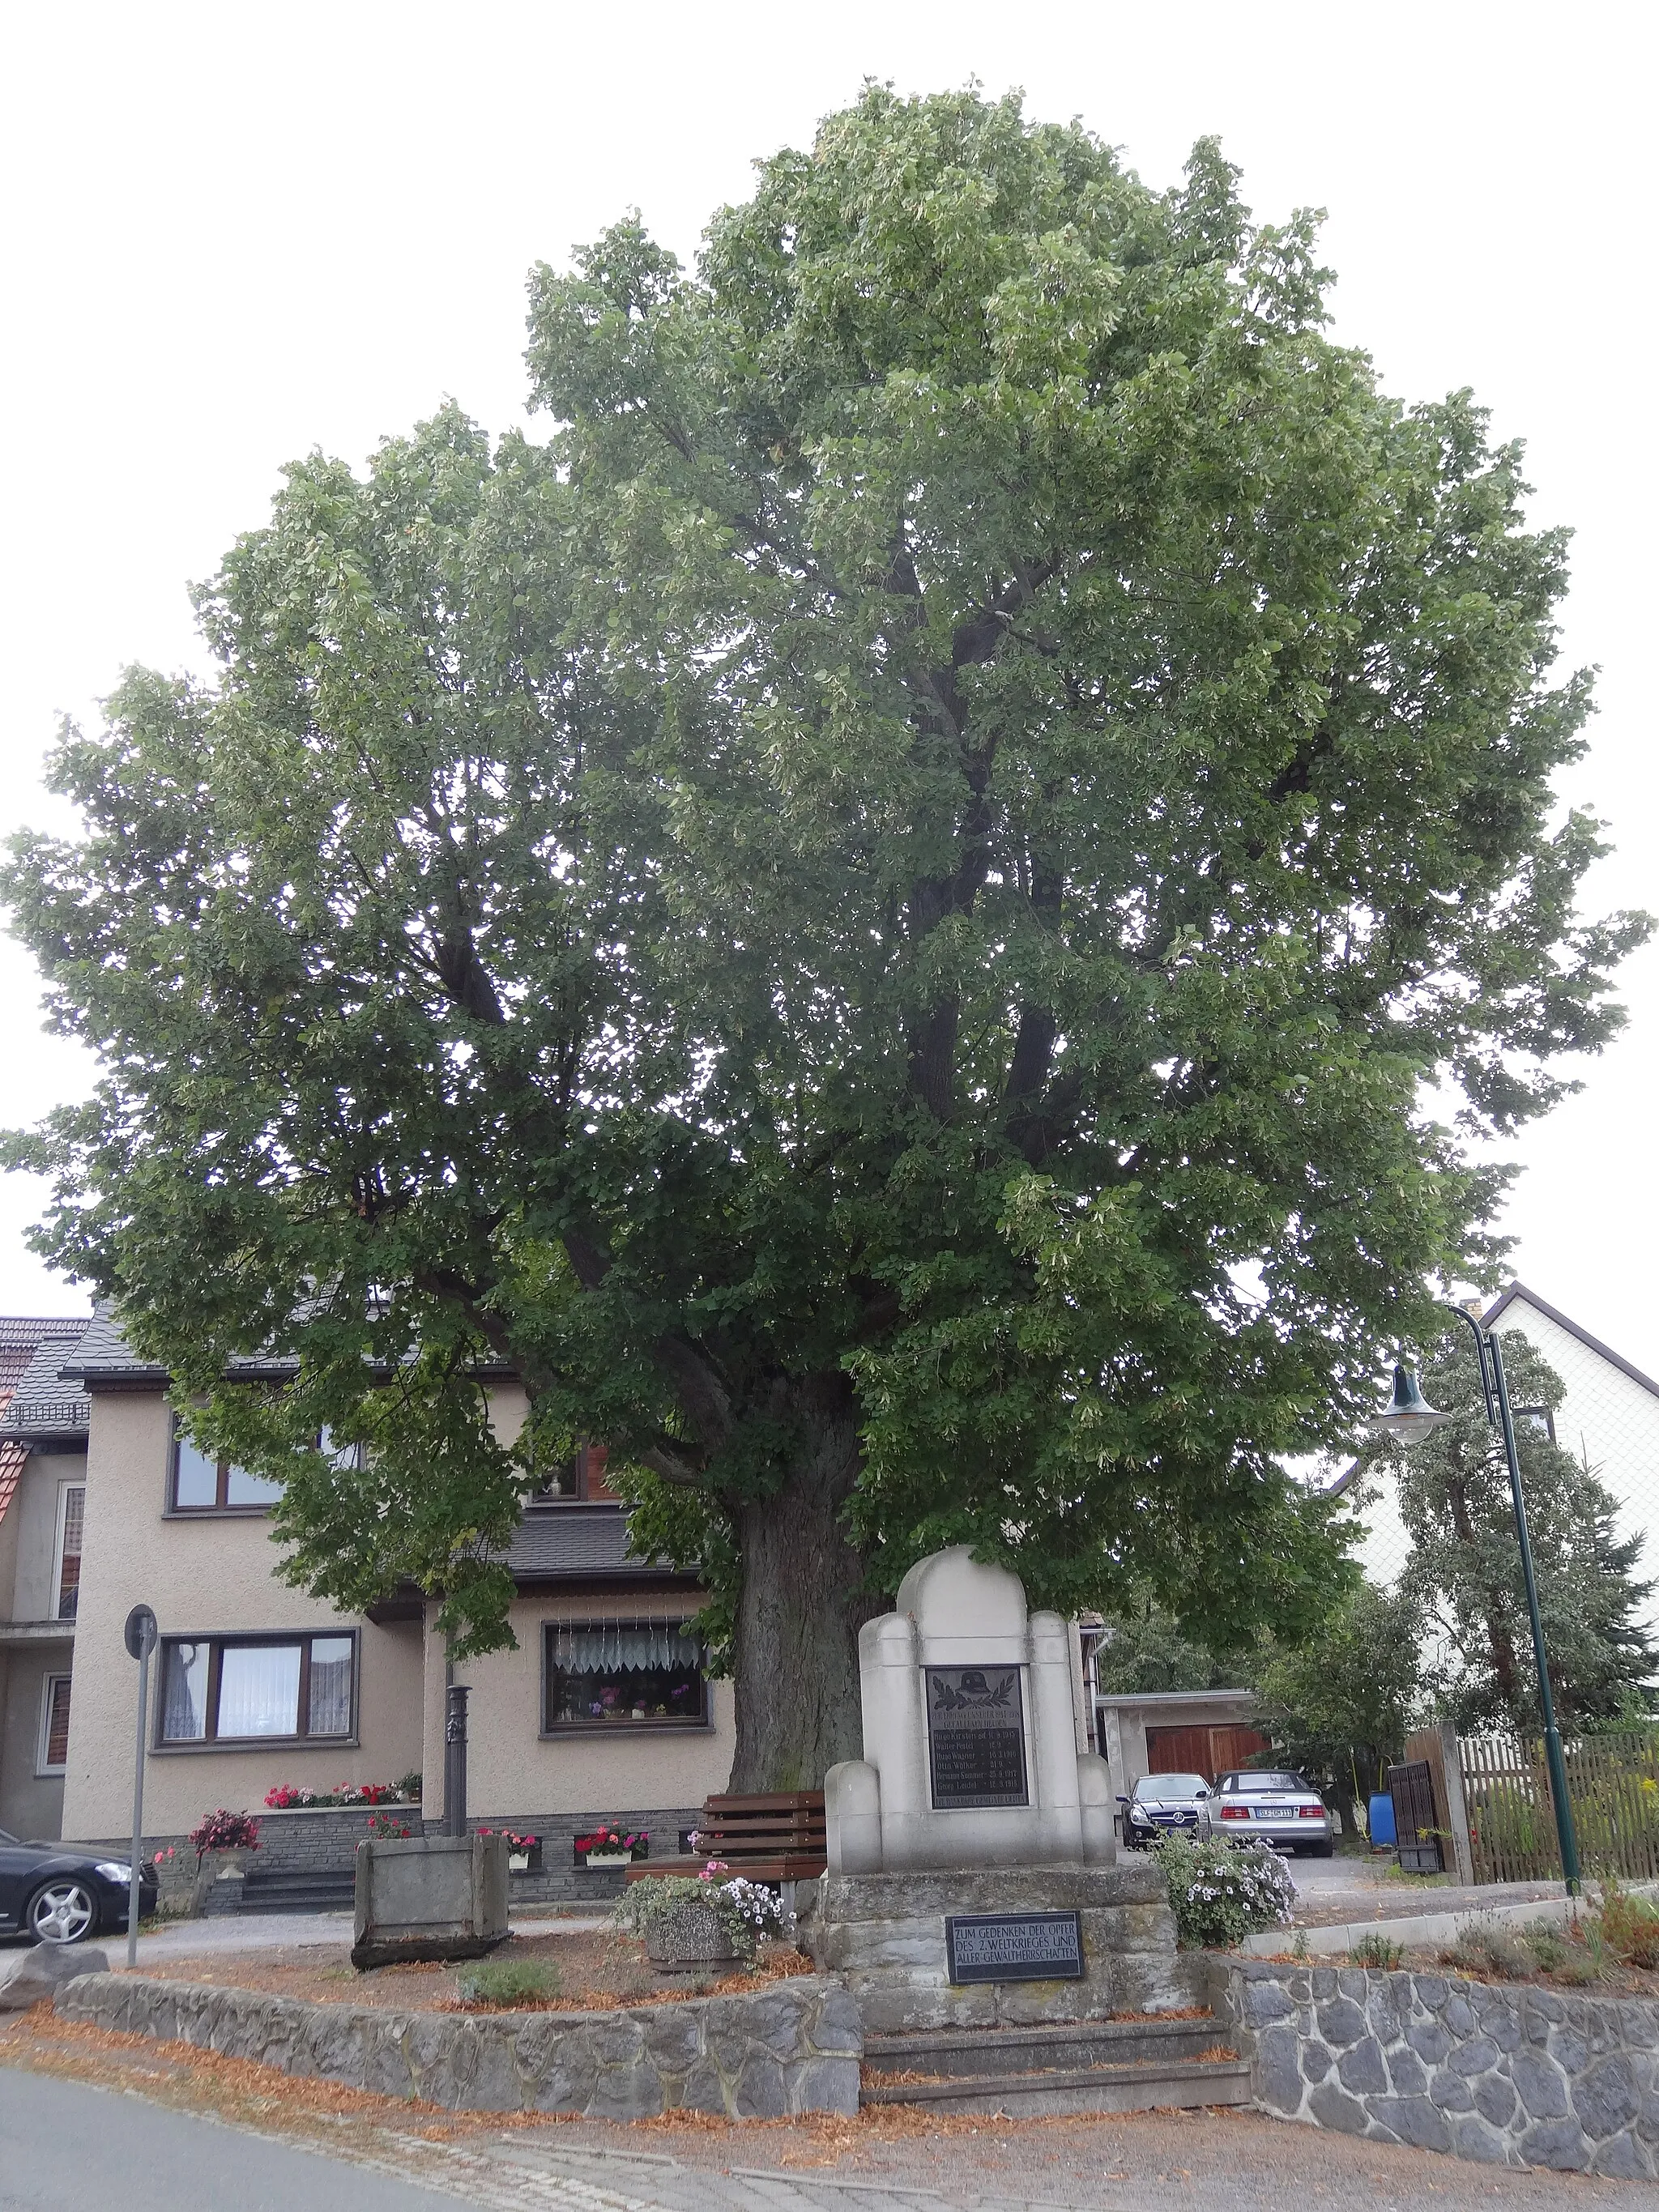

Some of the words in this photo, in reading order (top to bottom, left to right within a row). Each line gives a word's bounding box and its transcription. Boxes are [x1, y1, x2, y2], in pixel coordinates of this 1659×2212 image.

[955, 1929, 975, 1939] ZUM
[979, 1926, 1026, 1938] GEDENKEN
[1029, 1924, 1046, 1936] DER
[1048, 1924, 1075, 1935] OPFER
[955, 1941, 974, 1951] DES
[1053, 1936, 1076, 1946] UND
[957, 1952, 980, 1963] ALLER
[983, 1947, 1077, 1963] GEWALTHERRSCHAFTEN
